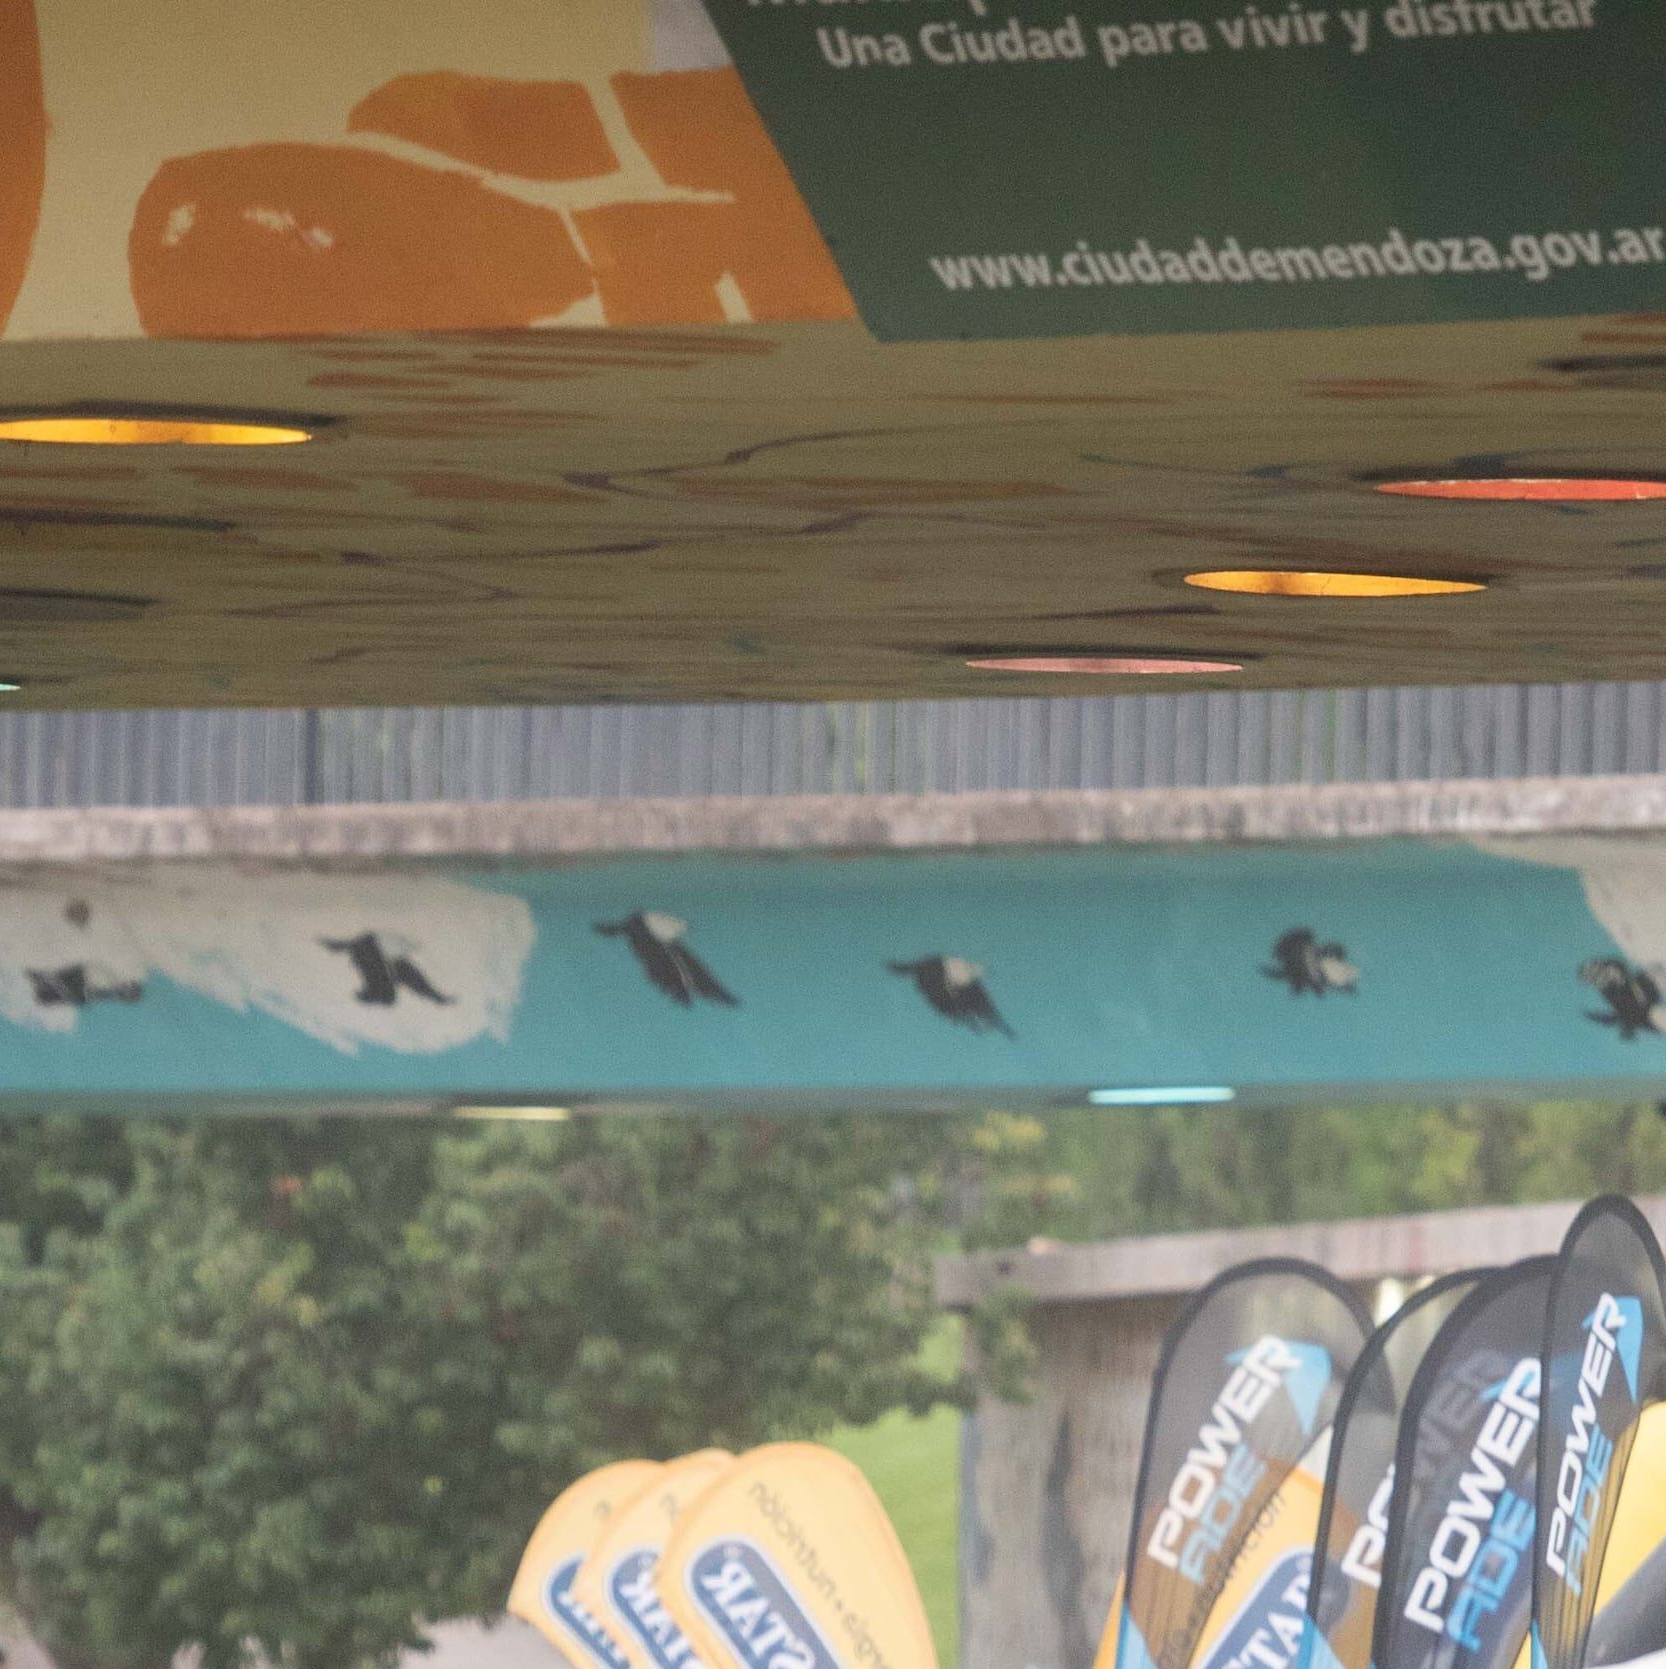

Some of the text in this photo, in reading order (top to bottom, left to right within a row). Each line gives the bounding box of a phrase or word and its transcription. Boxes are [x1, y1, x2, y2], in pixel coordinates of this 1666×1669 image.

[817, 0, 1597, 69] Una Ciudad para vivir y disfrutar
[1146, 1333, 1303, 1570] POWER
[1404, 1357, 1542, 1634] POWER
[1545, 1291, 1628, 1578] POWER
[1446, 1488, 1538, 1654] ADE
